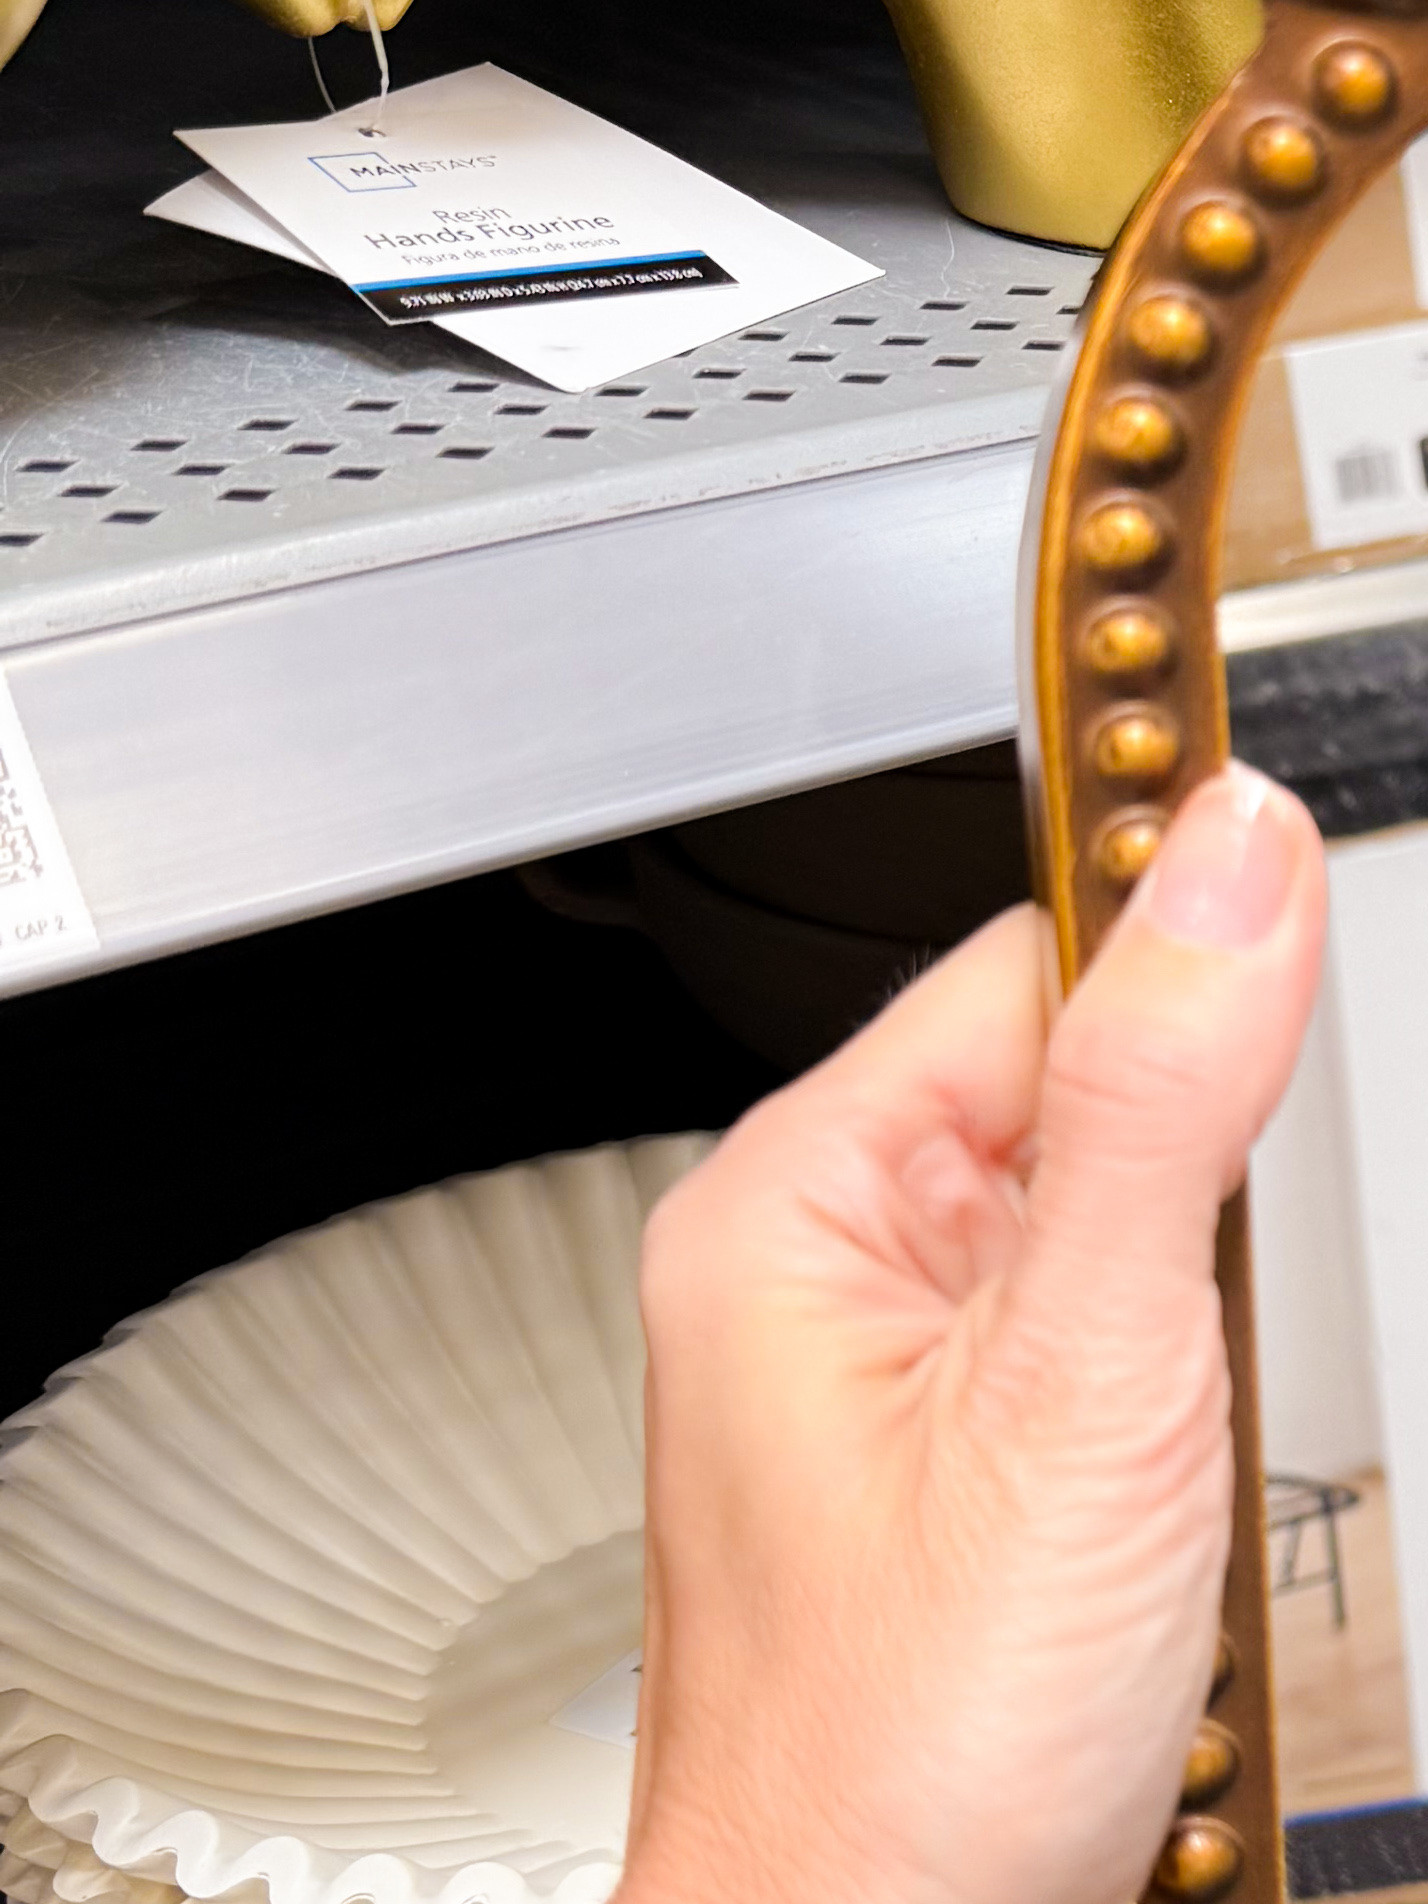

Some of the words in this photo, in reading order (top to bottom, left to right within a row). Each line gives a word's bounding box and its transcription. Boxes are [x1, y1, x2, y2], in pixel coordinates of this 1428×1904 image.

[350, 154, 495, 178] MAINSTAYS
[432, 204, 513, 225] Resin
[364, 222, 476, 251] Hands
[481, 212, 616, 243] Figurine
[400, 248, 459, 268] Figura
[463, 244, 487, 260] de
[490, 242, 541, 258] mano
[543, 238, 568, 253] de
[15, 919, 49, 942] CAP
